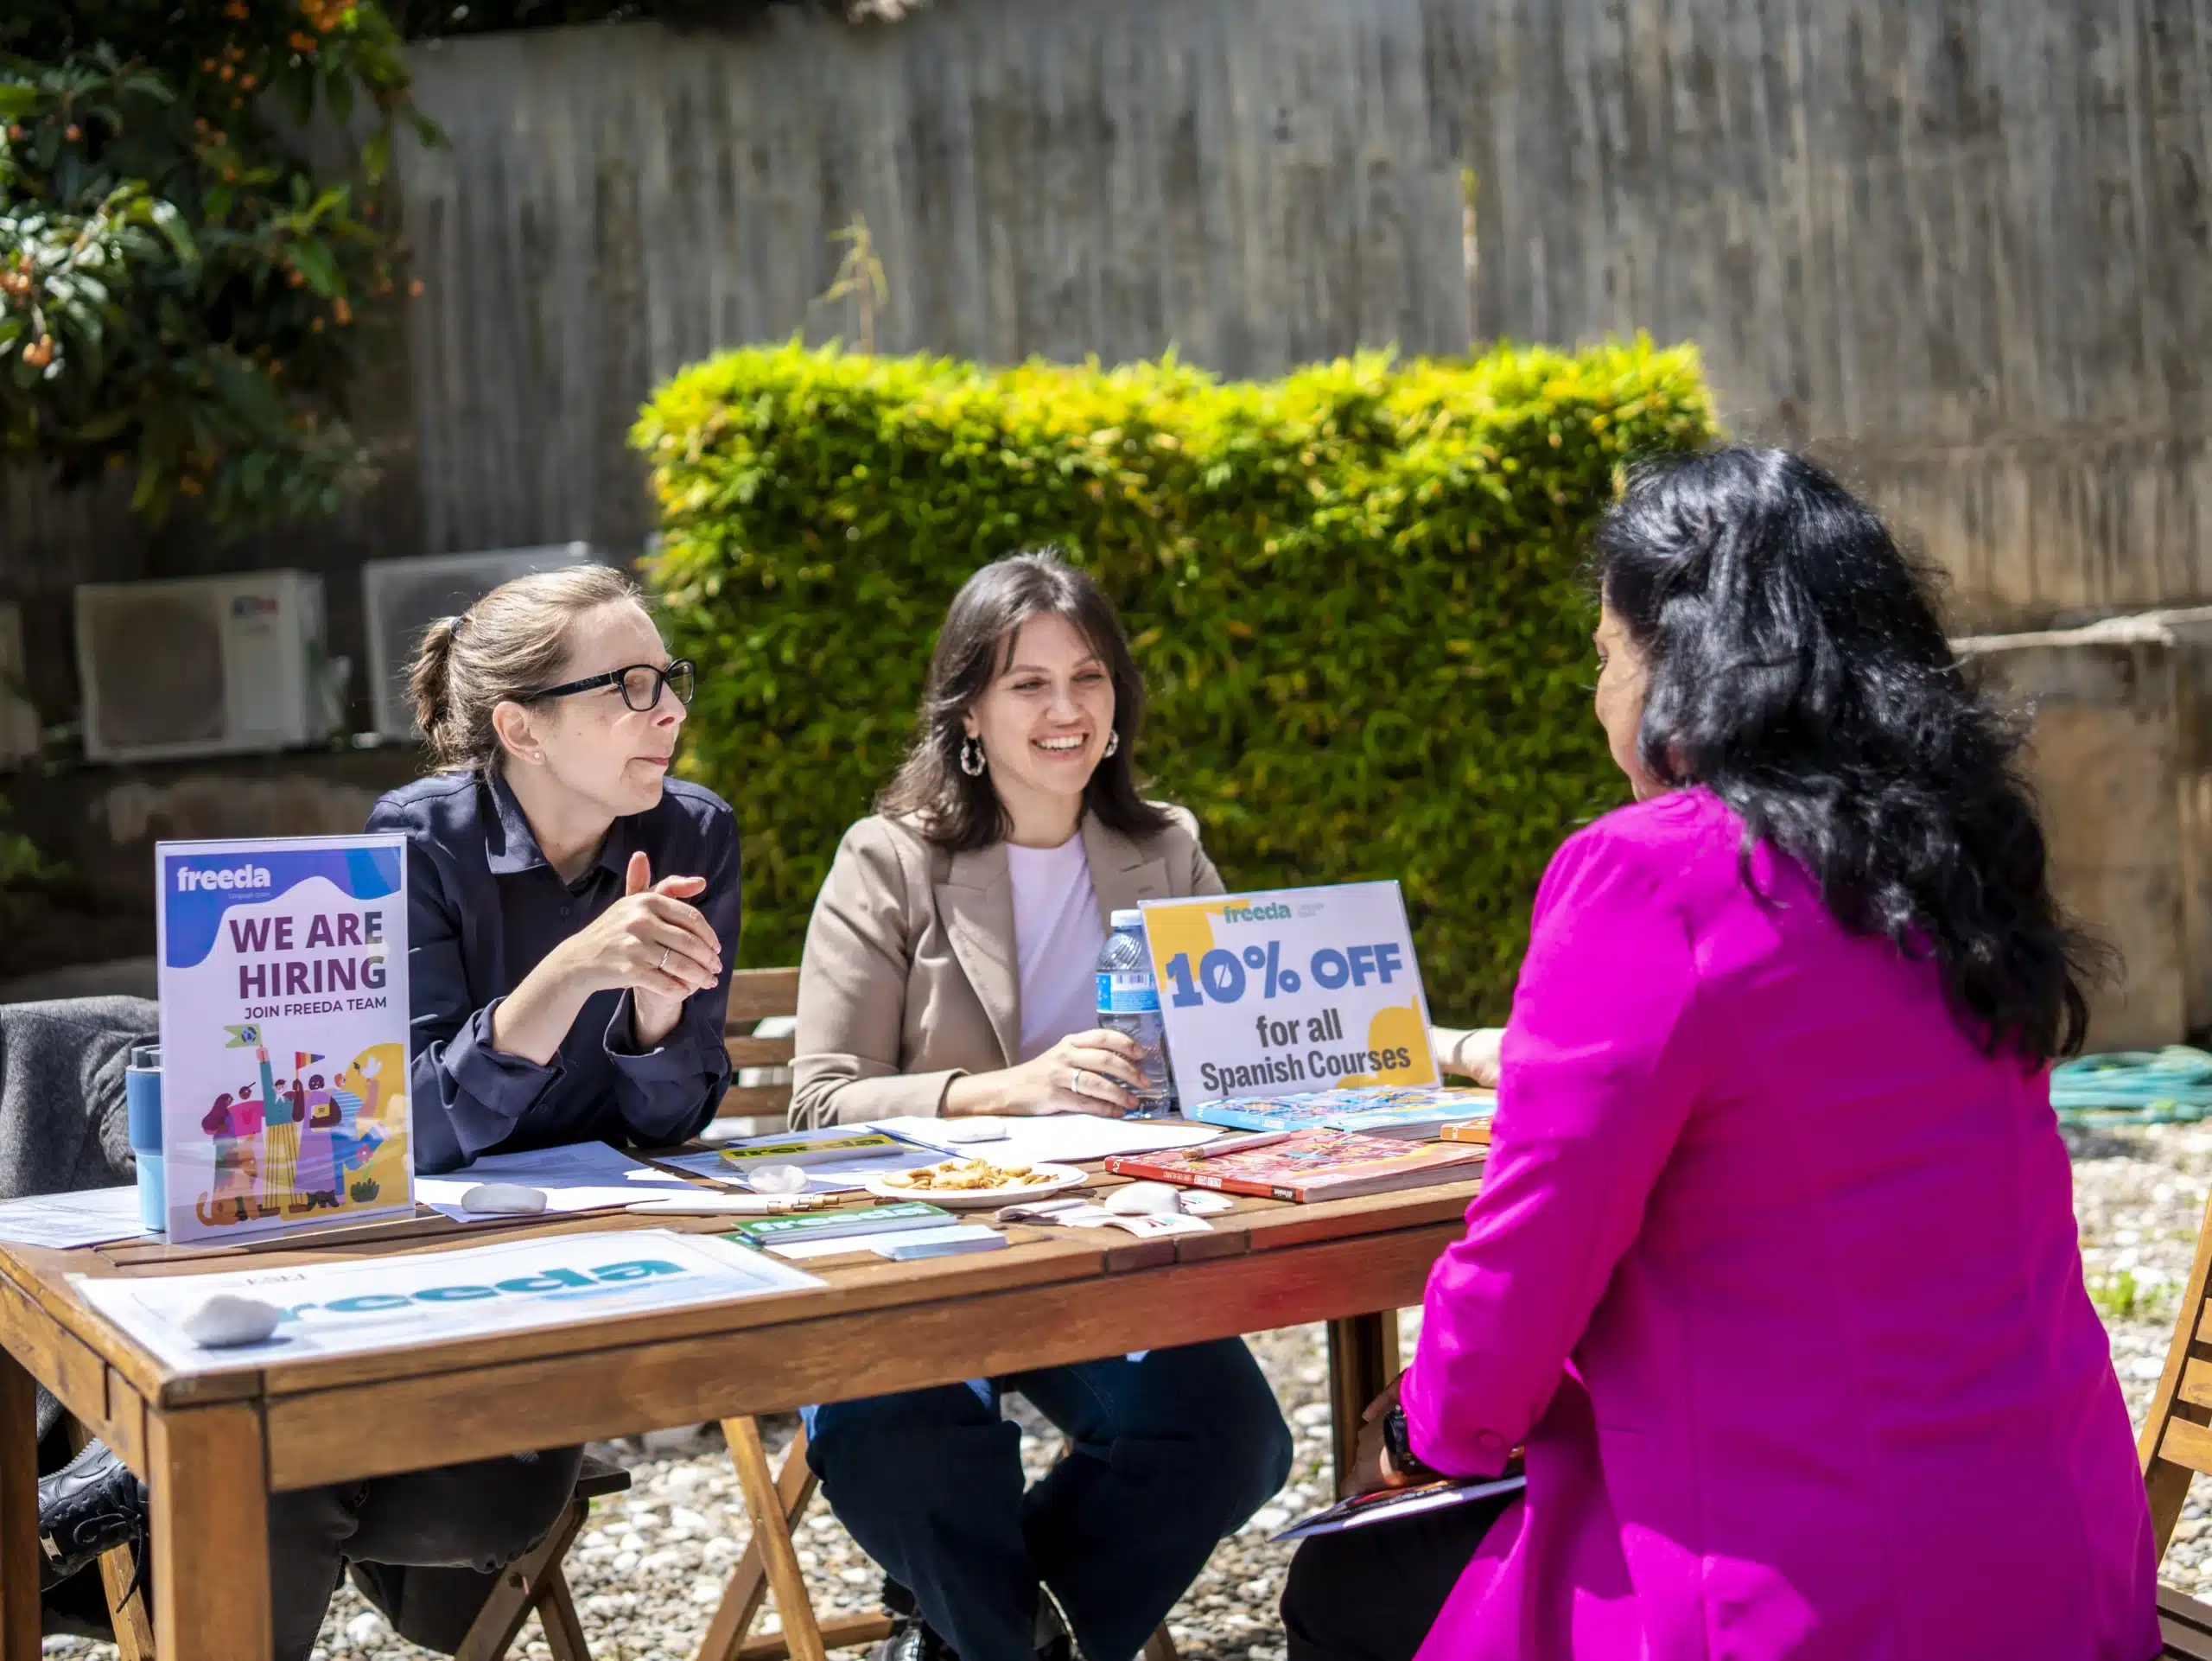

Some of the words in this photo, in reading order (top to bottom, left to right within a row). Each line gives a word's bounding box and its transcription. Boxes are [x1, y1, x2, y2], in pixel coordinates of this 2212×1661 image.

[176, 864, 270, 892] freeda
[229, 916, 294, 953] WE
[305, 911, 383, 948] ARE
[1224, 902, 1292, 924] freeda
[239, 955, 386, 999] HIRING
[1165, 940, 1301, 1008] 10%
[1310, 943, 1403, 990] OFF
[245, 1005, 280, 1020] JOIN
[284, 1000, 343, 1016] FREEDA
[346, 996, 386, 1010] TEAM
[1255, 1015, 1300, 1048] for
[1306, 1008, 1344, 1042] all
[1200, 1053, 1306, 1097] Spanish
[1307, 1047, 1412, 1079] Courses
[729, 1138, 885, 1158] freeda
[750, 1206, 931, 1231] freeda
[277, 1259, 687, 1322] reeda
